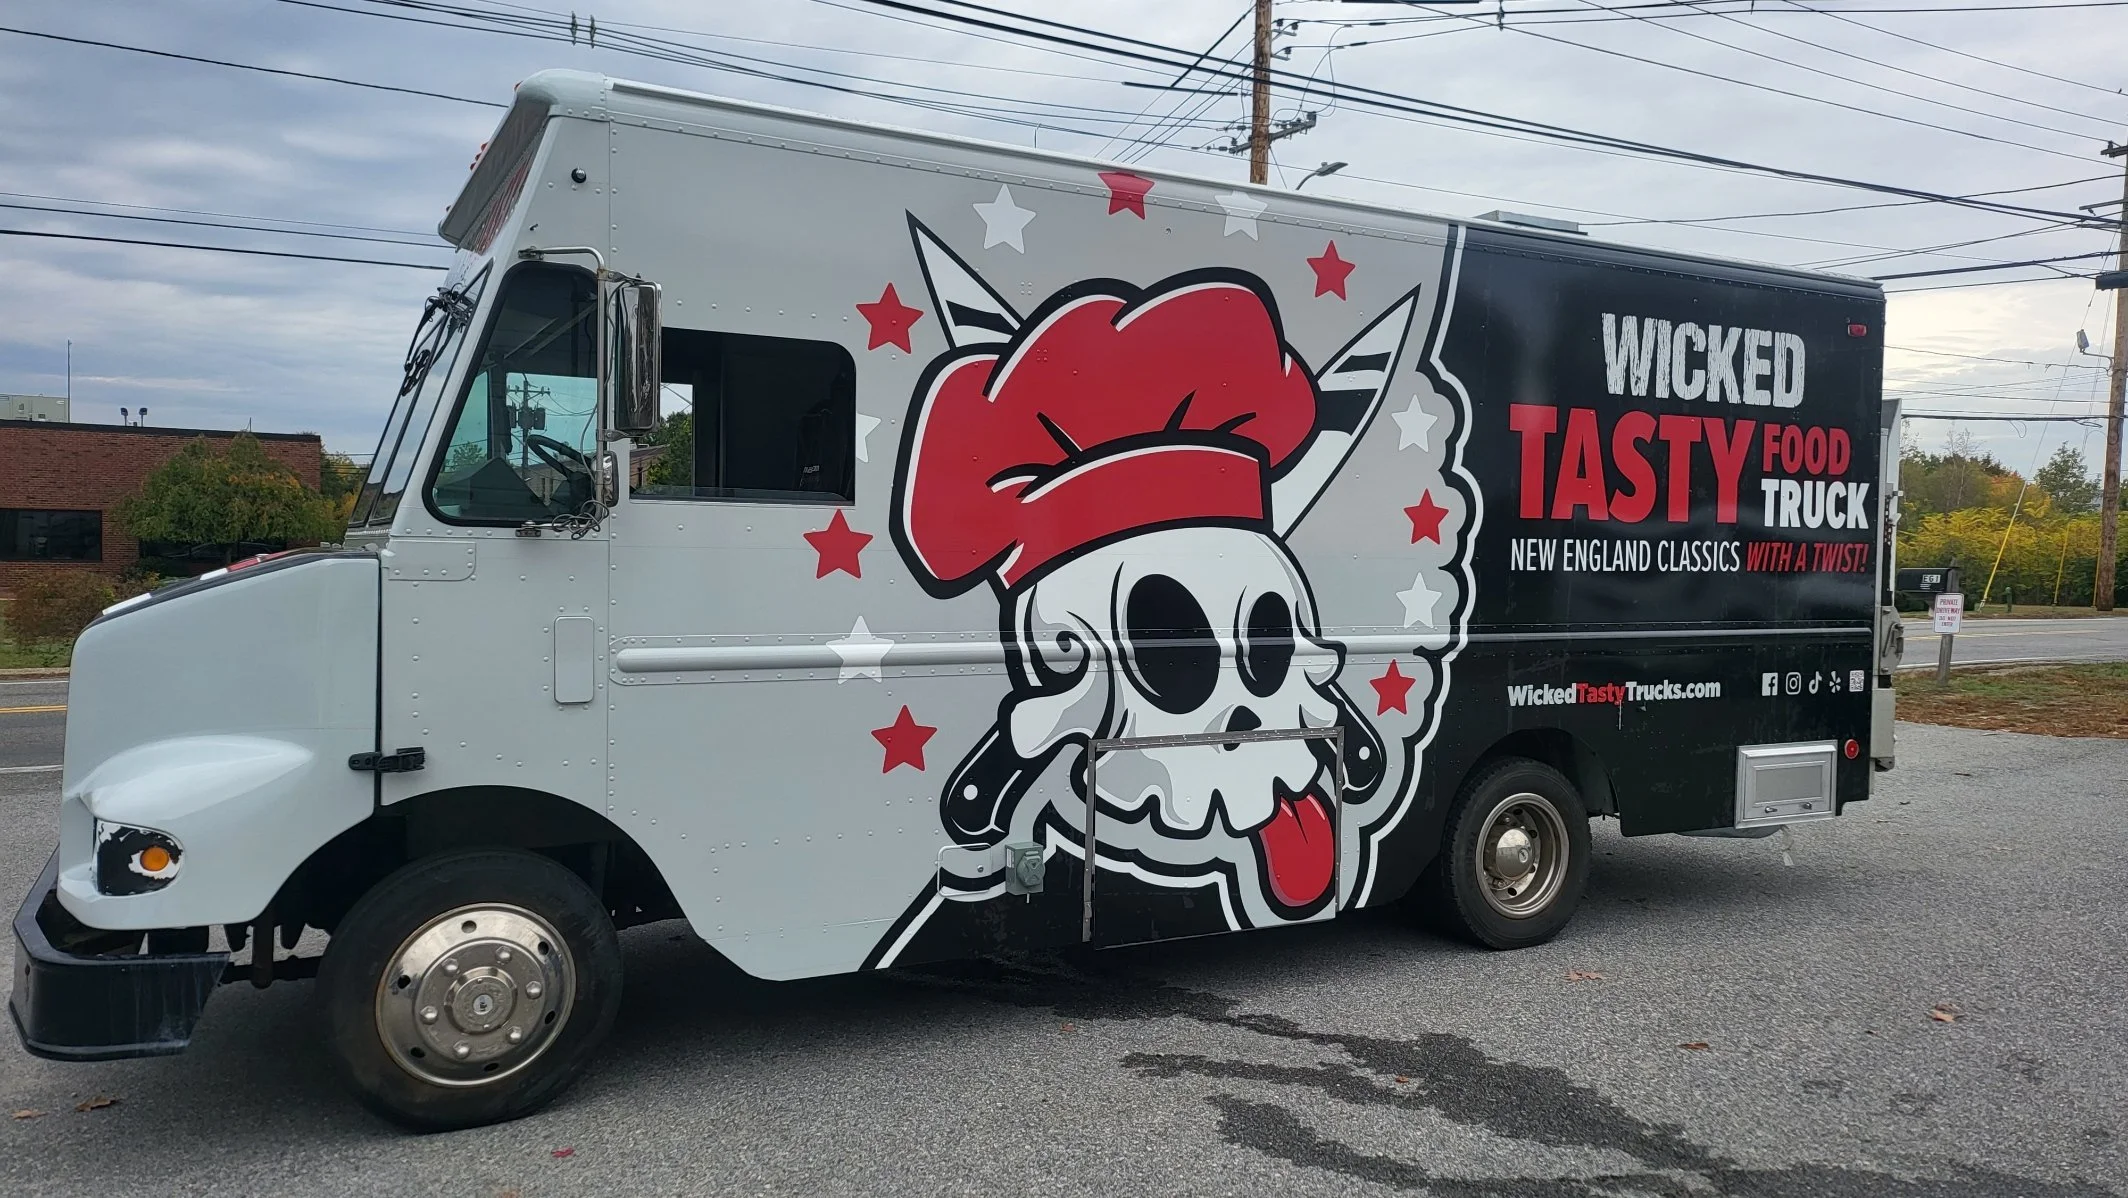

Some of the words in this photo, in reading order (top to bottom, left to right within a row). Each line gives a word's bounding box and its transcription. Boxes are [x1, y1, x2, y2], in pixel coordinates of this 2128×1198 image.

[1601, 312, 1806, 408] WICKED
[1509, 403, 1756, 524] TASTY
[1762, 424, 1851, 475] FOOD
[1761, 478, 1870, 530] TRUCK
[1510, 538, 1557, 571] NEW
[1563, 538, 1651, 572] ENGLAND
[1657, 539, 1740, 572] CLASSICS
[1746, 541, 1794, 573] WITH
[1794, 542, 1807, 573] A
[1812, 542, 1870, 573] TWIST!
[1507, 679, 1721, 707] WickedTastyTrucks.com
